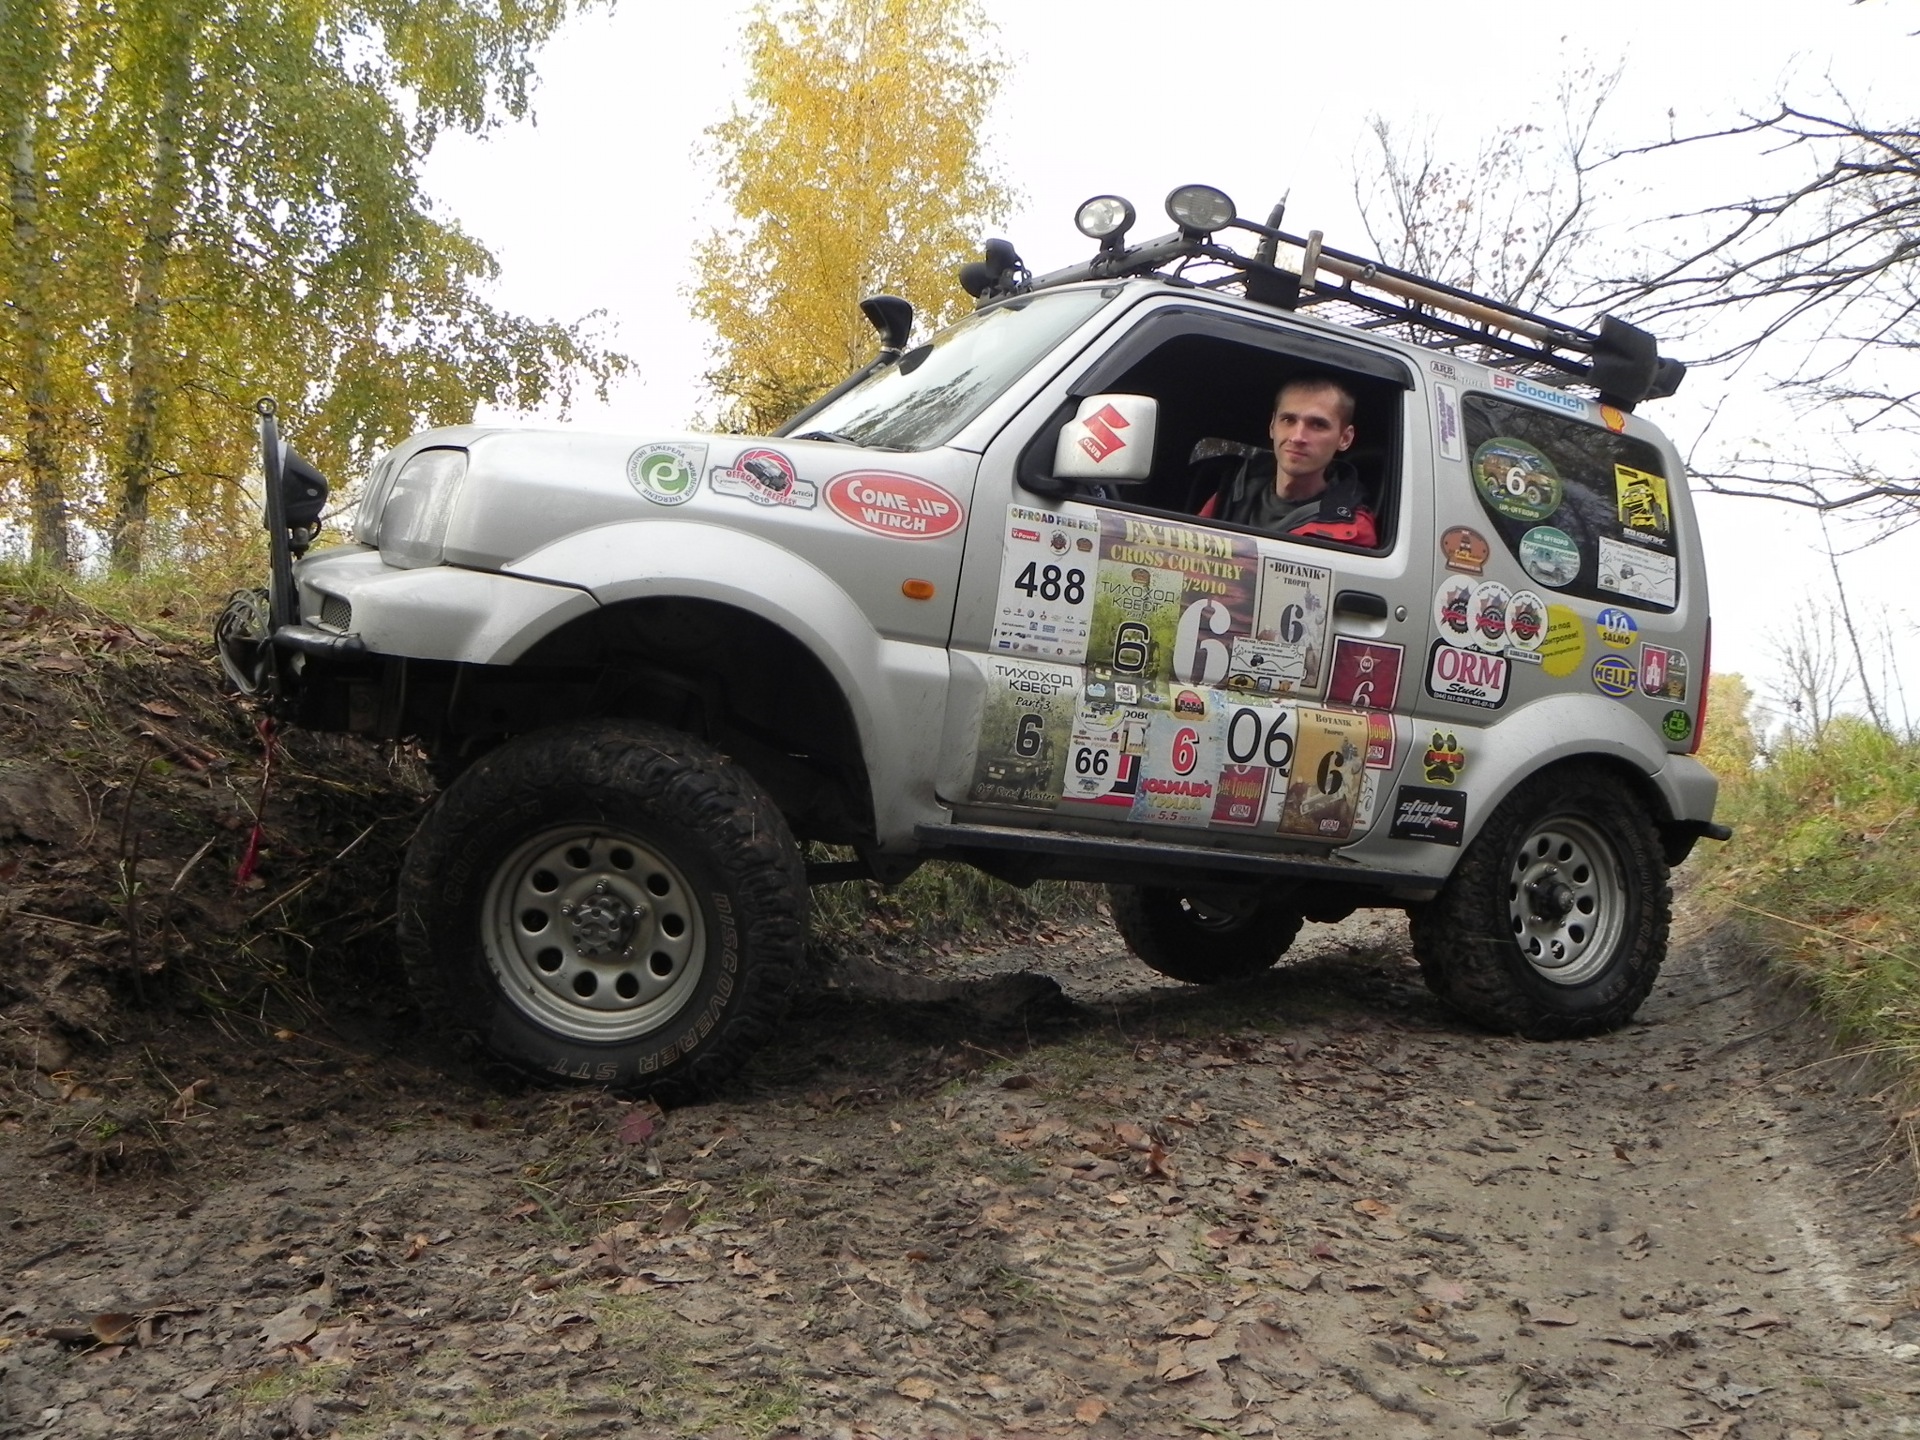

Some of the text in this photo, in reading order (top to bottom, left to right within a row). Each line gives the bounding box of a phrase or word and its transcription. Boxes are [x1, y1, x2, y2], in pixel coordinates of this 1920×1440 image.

[1433, 363, 1453, 375] ARB
[1493, 374, 1585, 411] BFGoodrich
[650, 444, 686, 459] ДЖЕРЕЛА
[1083, 438, 1102, 459] CLUB
[725, 469, 763, 491] OFFROAD
[1506, 466, 1527, 496] 6
[748, 491, 771, 504] 2010
[860, 506, 927, 532] WINCH
[1010, 507, 1099, 533] OFFROAD FREE FEST
[1013, 530, 1038, 542] V-Power
[1124, 519, 1234, 561] EXTREM
[1110, 544, 1245, 581] CROSS COUNTRY
[1274, 562, 1322, 581] BOTANIK
[1014, 561, 1086, 606] 488
[1101, 581, 1175, 605] ТИХОХОД
[1283, 577, 1311, 589] TROPHY
[1112, 596, 1162, 614] КВЕСТ
[1280, 603, 1304, 644] 6
[1604, 613, 1630, 636] UA
[1112, 620, 1151, 674] 6
[1172, 598, 1232, 686] 6
[1541, 630, 1579, 647] онтролем!
[1602, 631, 1631, 645] SALMO
[995, 665, 1074, 688] ТИХОХОД
[1437, 648, 1504, 690] ORM
[1595, 666, 1638, 690] HELLA
[1008, 678, 1061, 696] КВЕСТ
[1351, 680, 1375, 708] 6
[1446, 682, 1487, 699] Studio
[1015, 696, 1041, 710] Part
[1315, 713, 1352, 727] BOTANIK
[1015, 713, 1044, 759] 6
[1226, 707, 1294, 768] 06
[1323, 727, 1345, 737] TROPHY
[1370, 723, 1391, 741] рофи
[1074, 747, 1110, 776] 66
[1171, 725, 1200, 776] 6
[1316, 750, 1345, 795] 6
[1022, 788, 1056, 801] Master
[1142, 777, 1213, 799] ЮБИЛЕЙ
[1157, 810, 1179, 821] 5.5
[1231, 804, 1250, 815] ORM
[1400, 799, 1454, 816] studio
[1321, 819, 1340, 830] ORM
[1396, 812, 1437, 829] pilot
[638, 892, 739, 1075] DISCOVERER
[547, 1057, 619, 1081] STT
